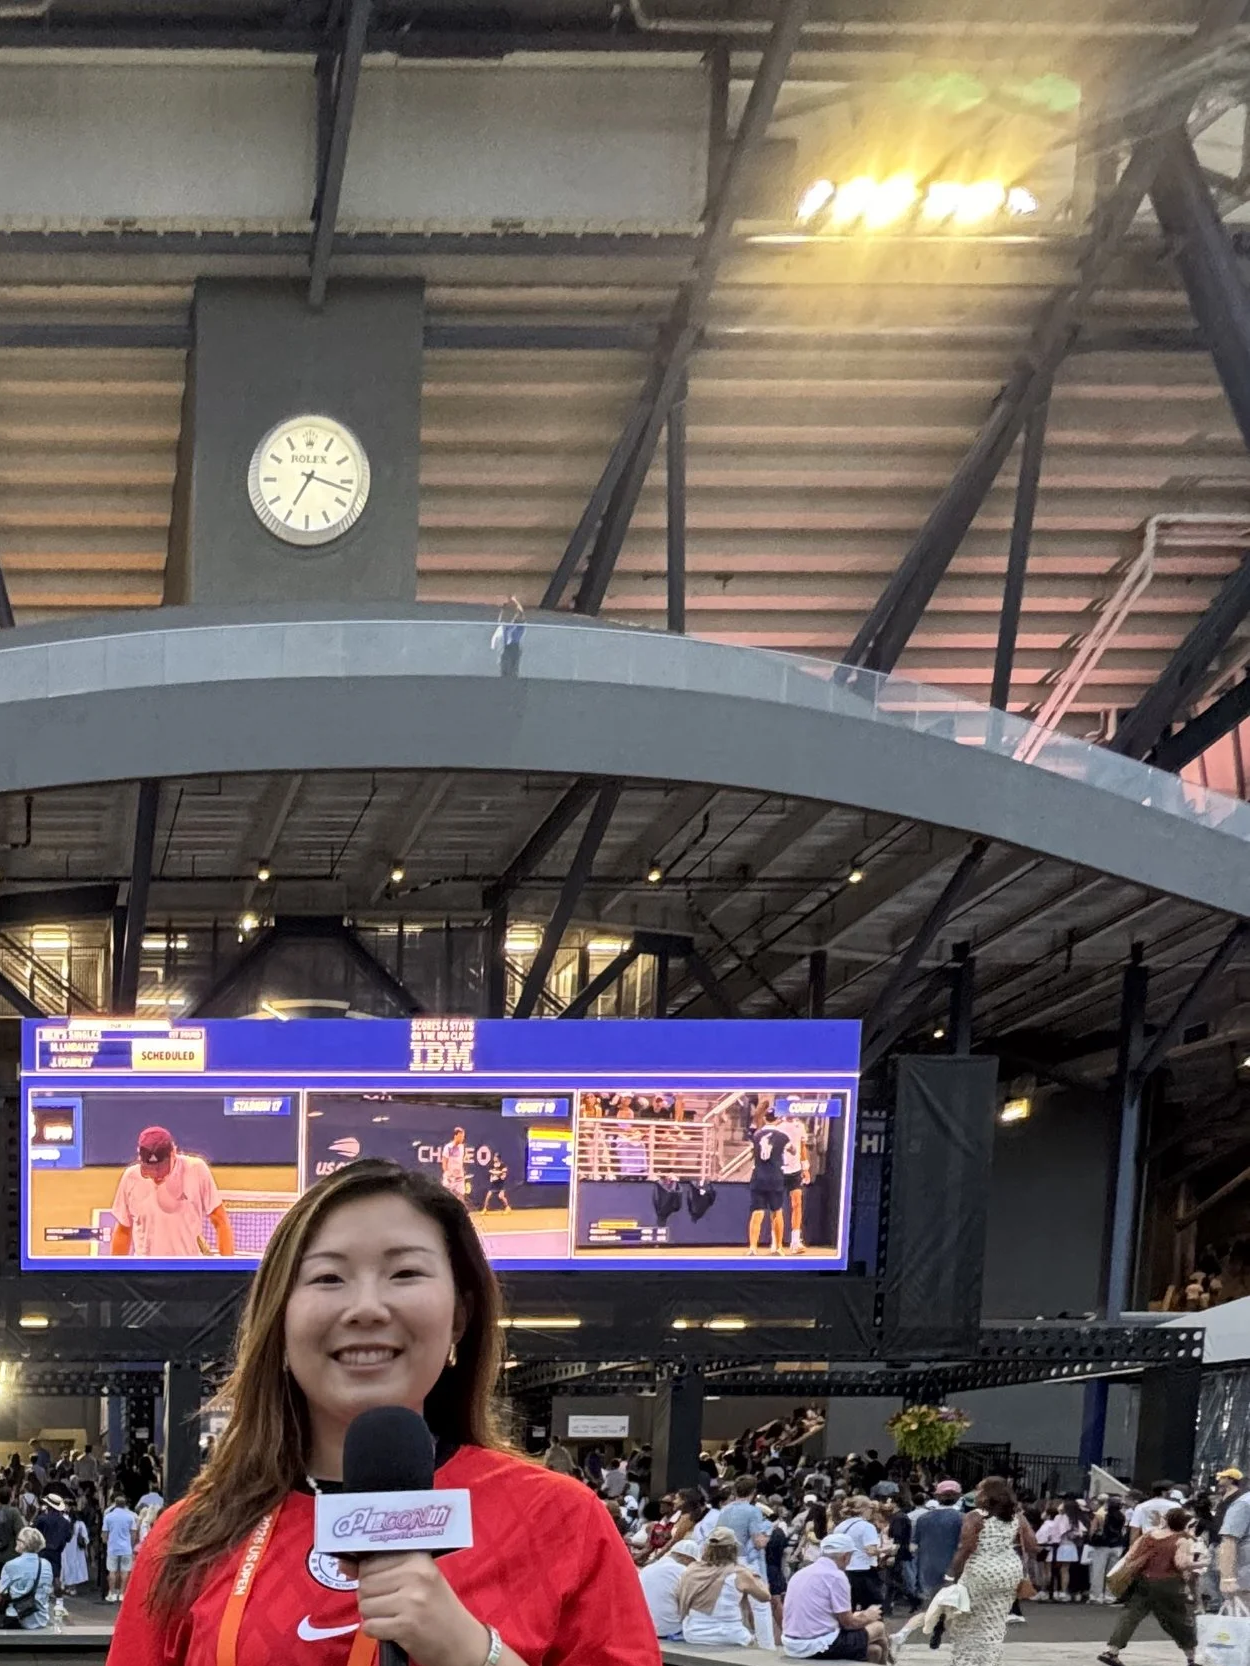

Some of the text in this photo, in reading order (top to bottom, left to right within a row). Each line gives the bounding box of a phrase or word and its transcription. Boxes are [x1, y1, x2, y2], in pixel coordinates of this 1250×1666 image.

[291, 454, 327, 464] ROLEX
[411, 1019, 474, 1031] SCORES & STATS
[411, 1031, 422, 1041] ON
[423, 1031, 436, 1041] THE
[451, 1031, 474, 1041] CLOUD
[141, 1051, 195, 1061] SCHEDULED
[410, 1041, 474, 1071] IBM
[246, 1545, 262, 1562] US
[234, 1562, 255, 1596] OPEN
